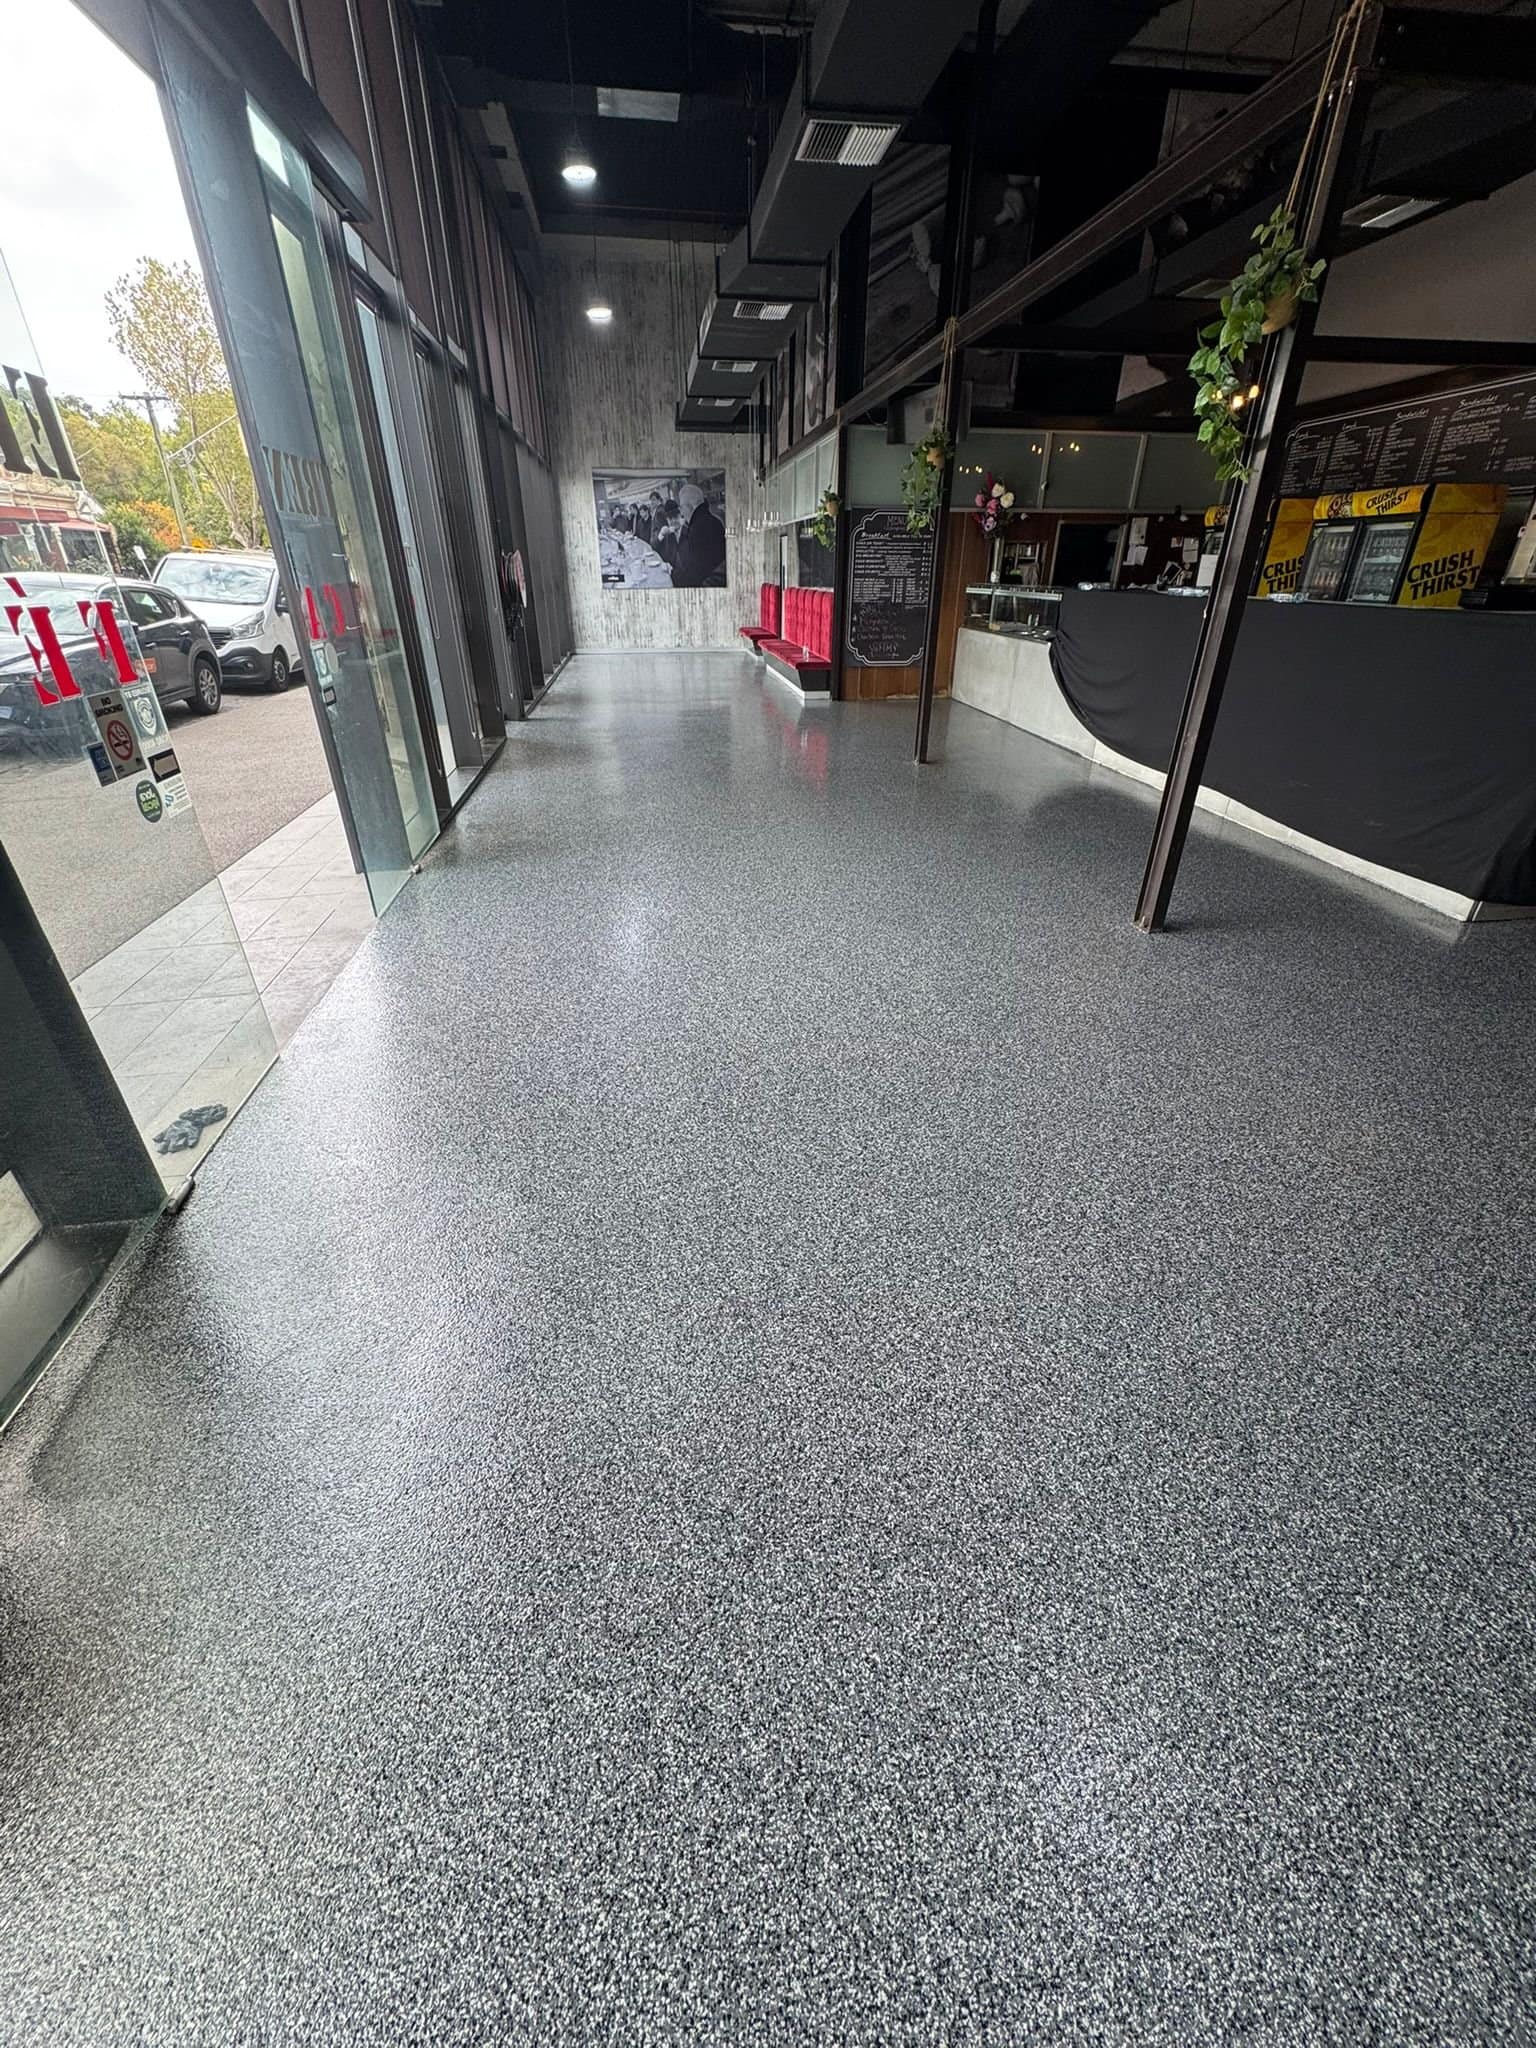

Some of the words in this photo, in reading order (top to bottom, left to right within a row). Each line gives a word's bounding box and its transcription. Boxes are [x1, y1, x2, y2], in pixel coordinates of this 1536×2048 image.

[1366, 488, 1398, 508] CRUSH
[1375, 491, 1409, 516] THIRST
[1407, 549, 1474, 584] CRUSH
[1410, 565, 1482, 601] THIRST
